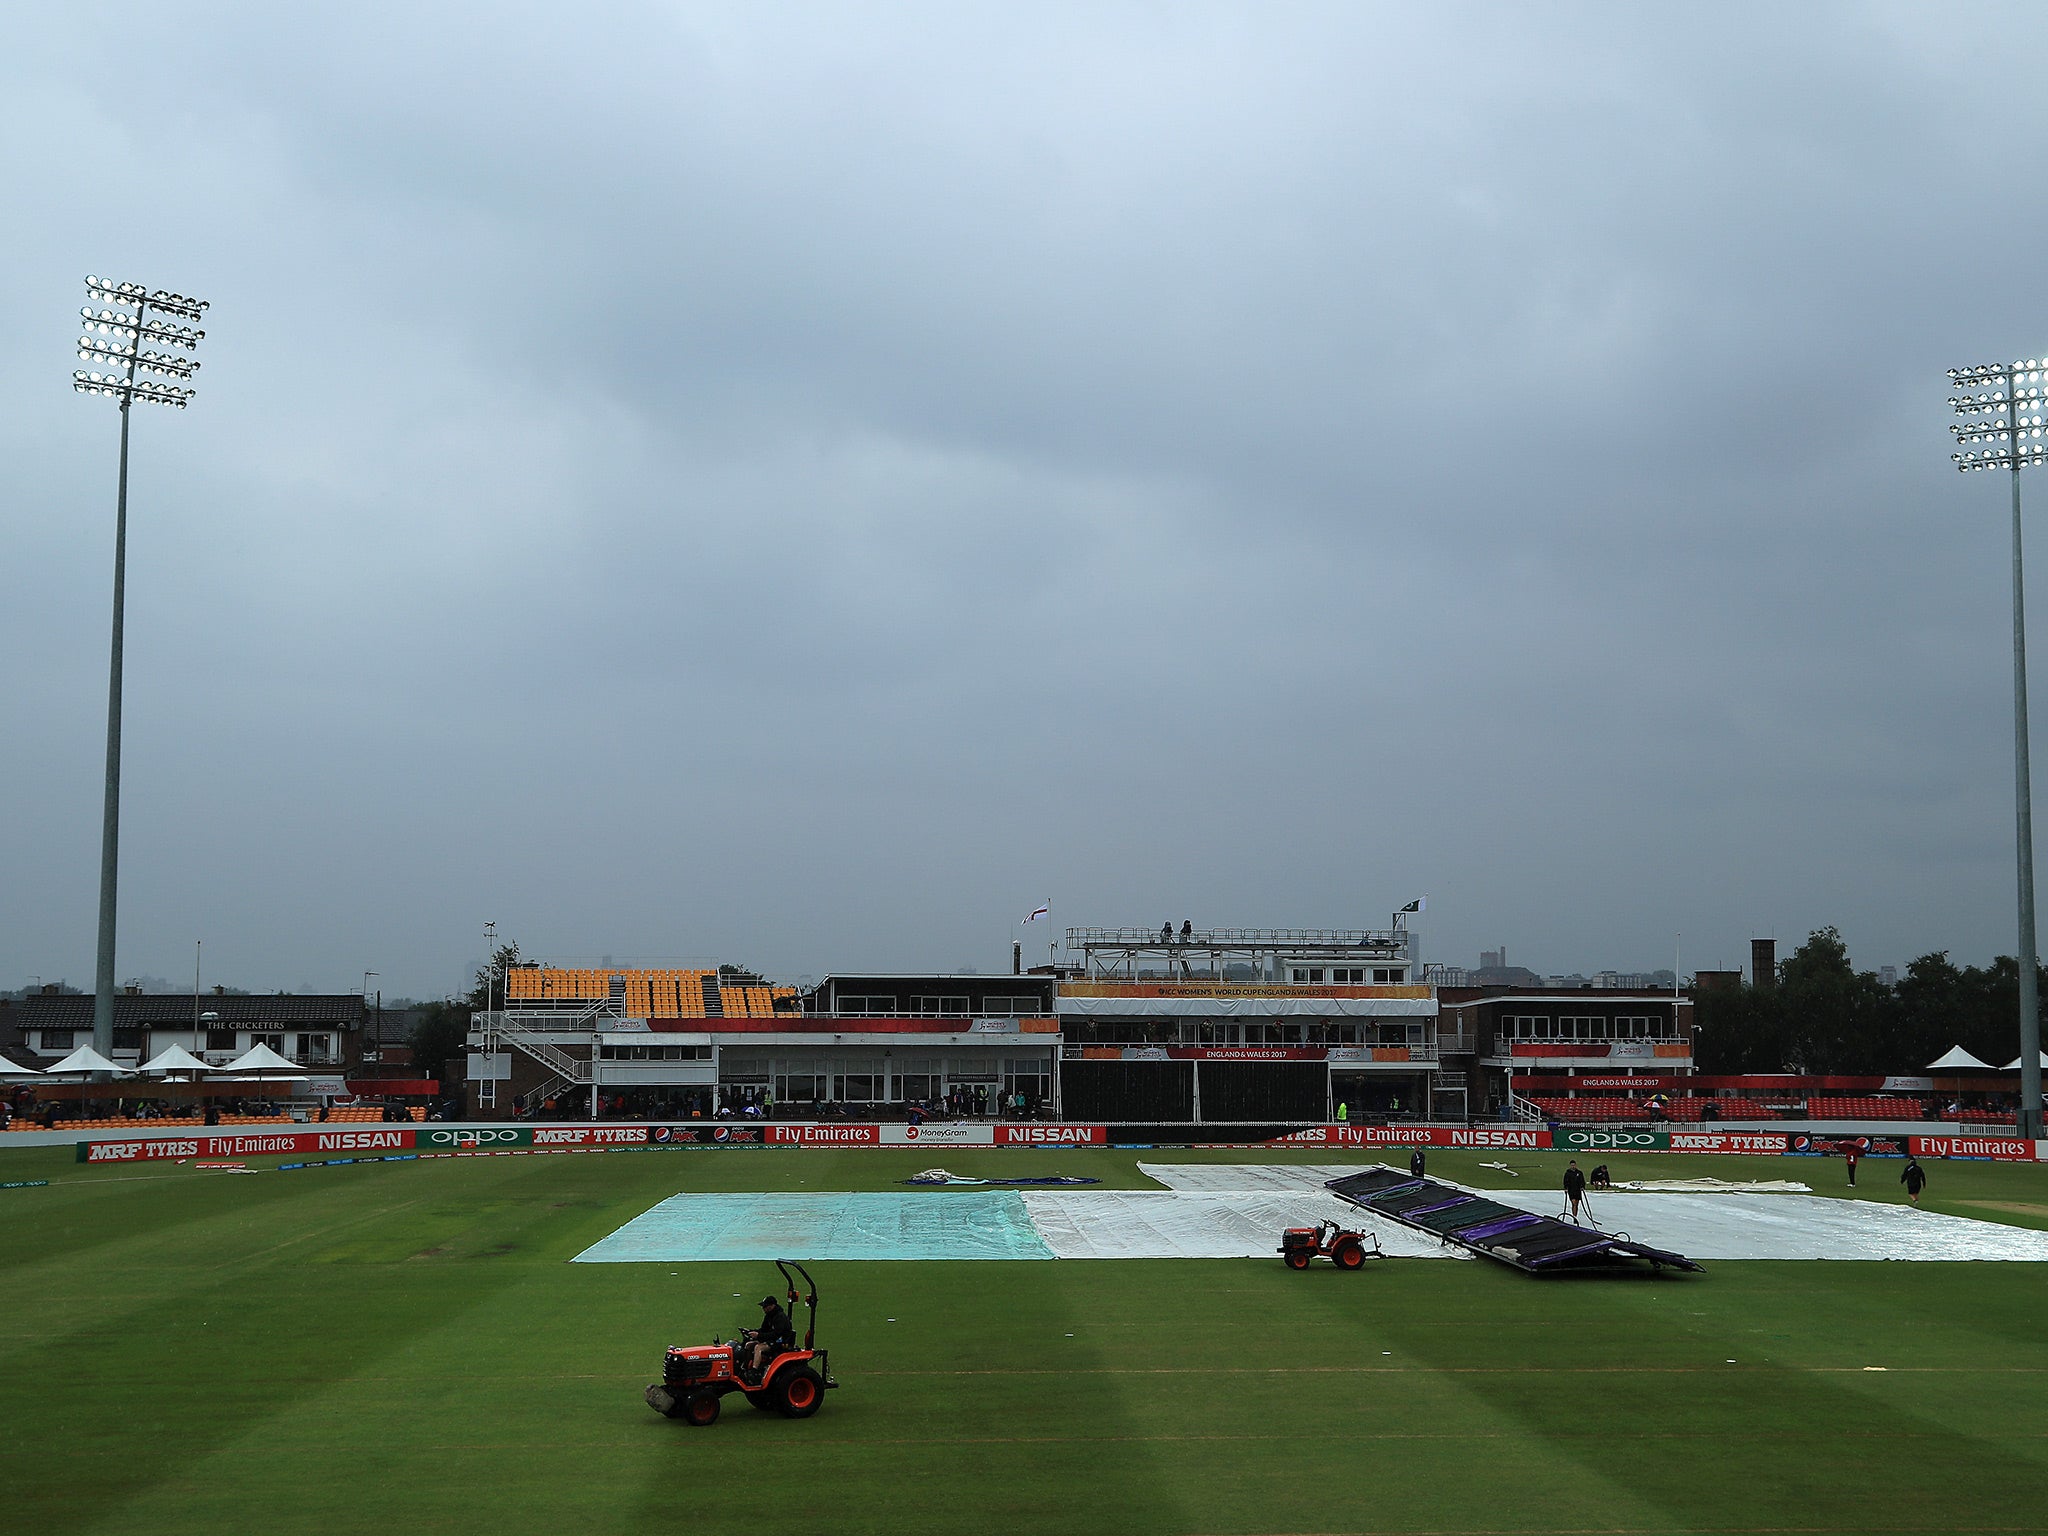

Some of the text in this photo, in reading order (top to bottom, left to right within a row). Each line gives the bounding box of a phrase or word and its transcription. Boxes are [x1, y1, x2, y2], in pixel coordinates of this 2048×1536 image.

[1242, 988, 1257, 996] CUP
[207, 1021, 285, 1030] THE CRICKETERS
[319, 1132, 402, 1149] NISSAN
[431, 1129, 518, 1146] oppo
[533, 1128, 648, 1143] MRF TYRES
[775, 1126, 871, 1143] Fly Emirates
[920, 1128, 968, 1138] MoneyGram
[1008, 1128, 1092, 1142] NISSAN
[1338, 1127, 1432, 1144] Fly Emirates
[1452, 1130, 1537, 1147] NISSAN
[1568, 1132, 1655, 1148] oppo
[89, 1140, 198, 1160] MRF TYRES
[209, 1135, 295, 1156] Fly Emirates
[1670, 1135, 1787, 1150] MRF TYRES
[1920, 1137, 2025, 1155] Fly Emirates
